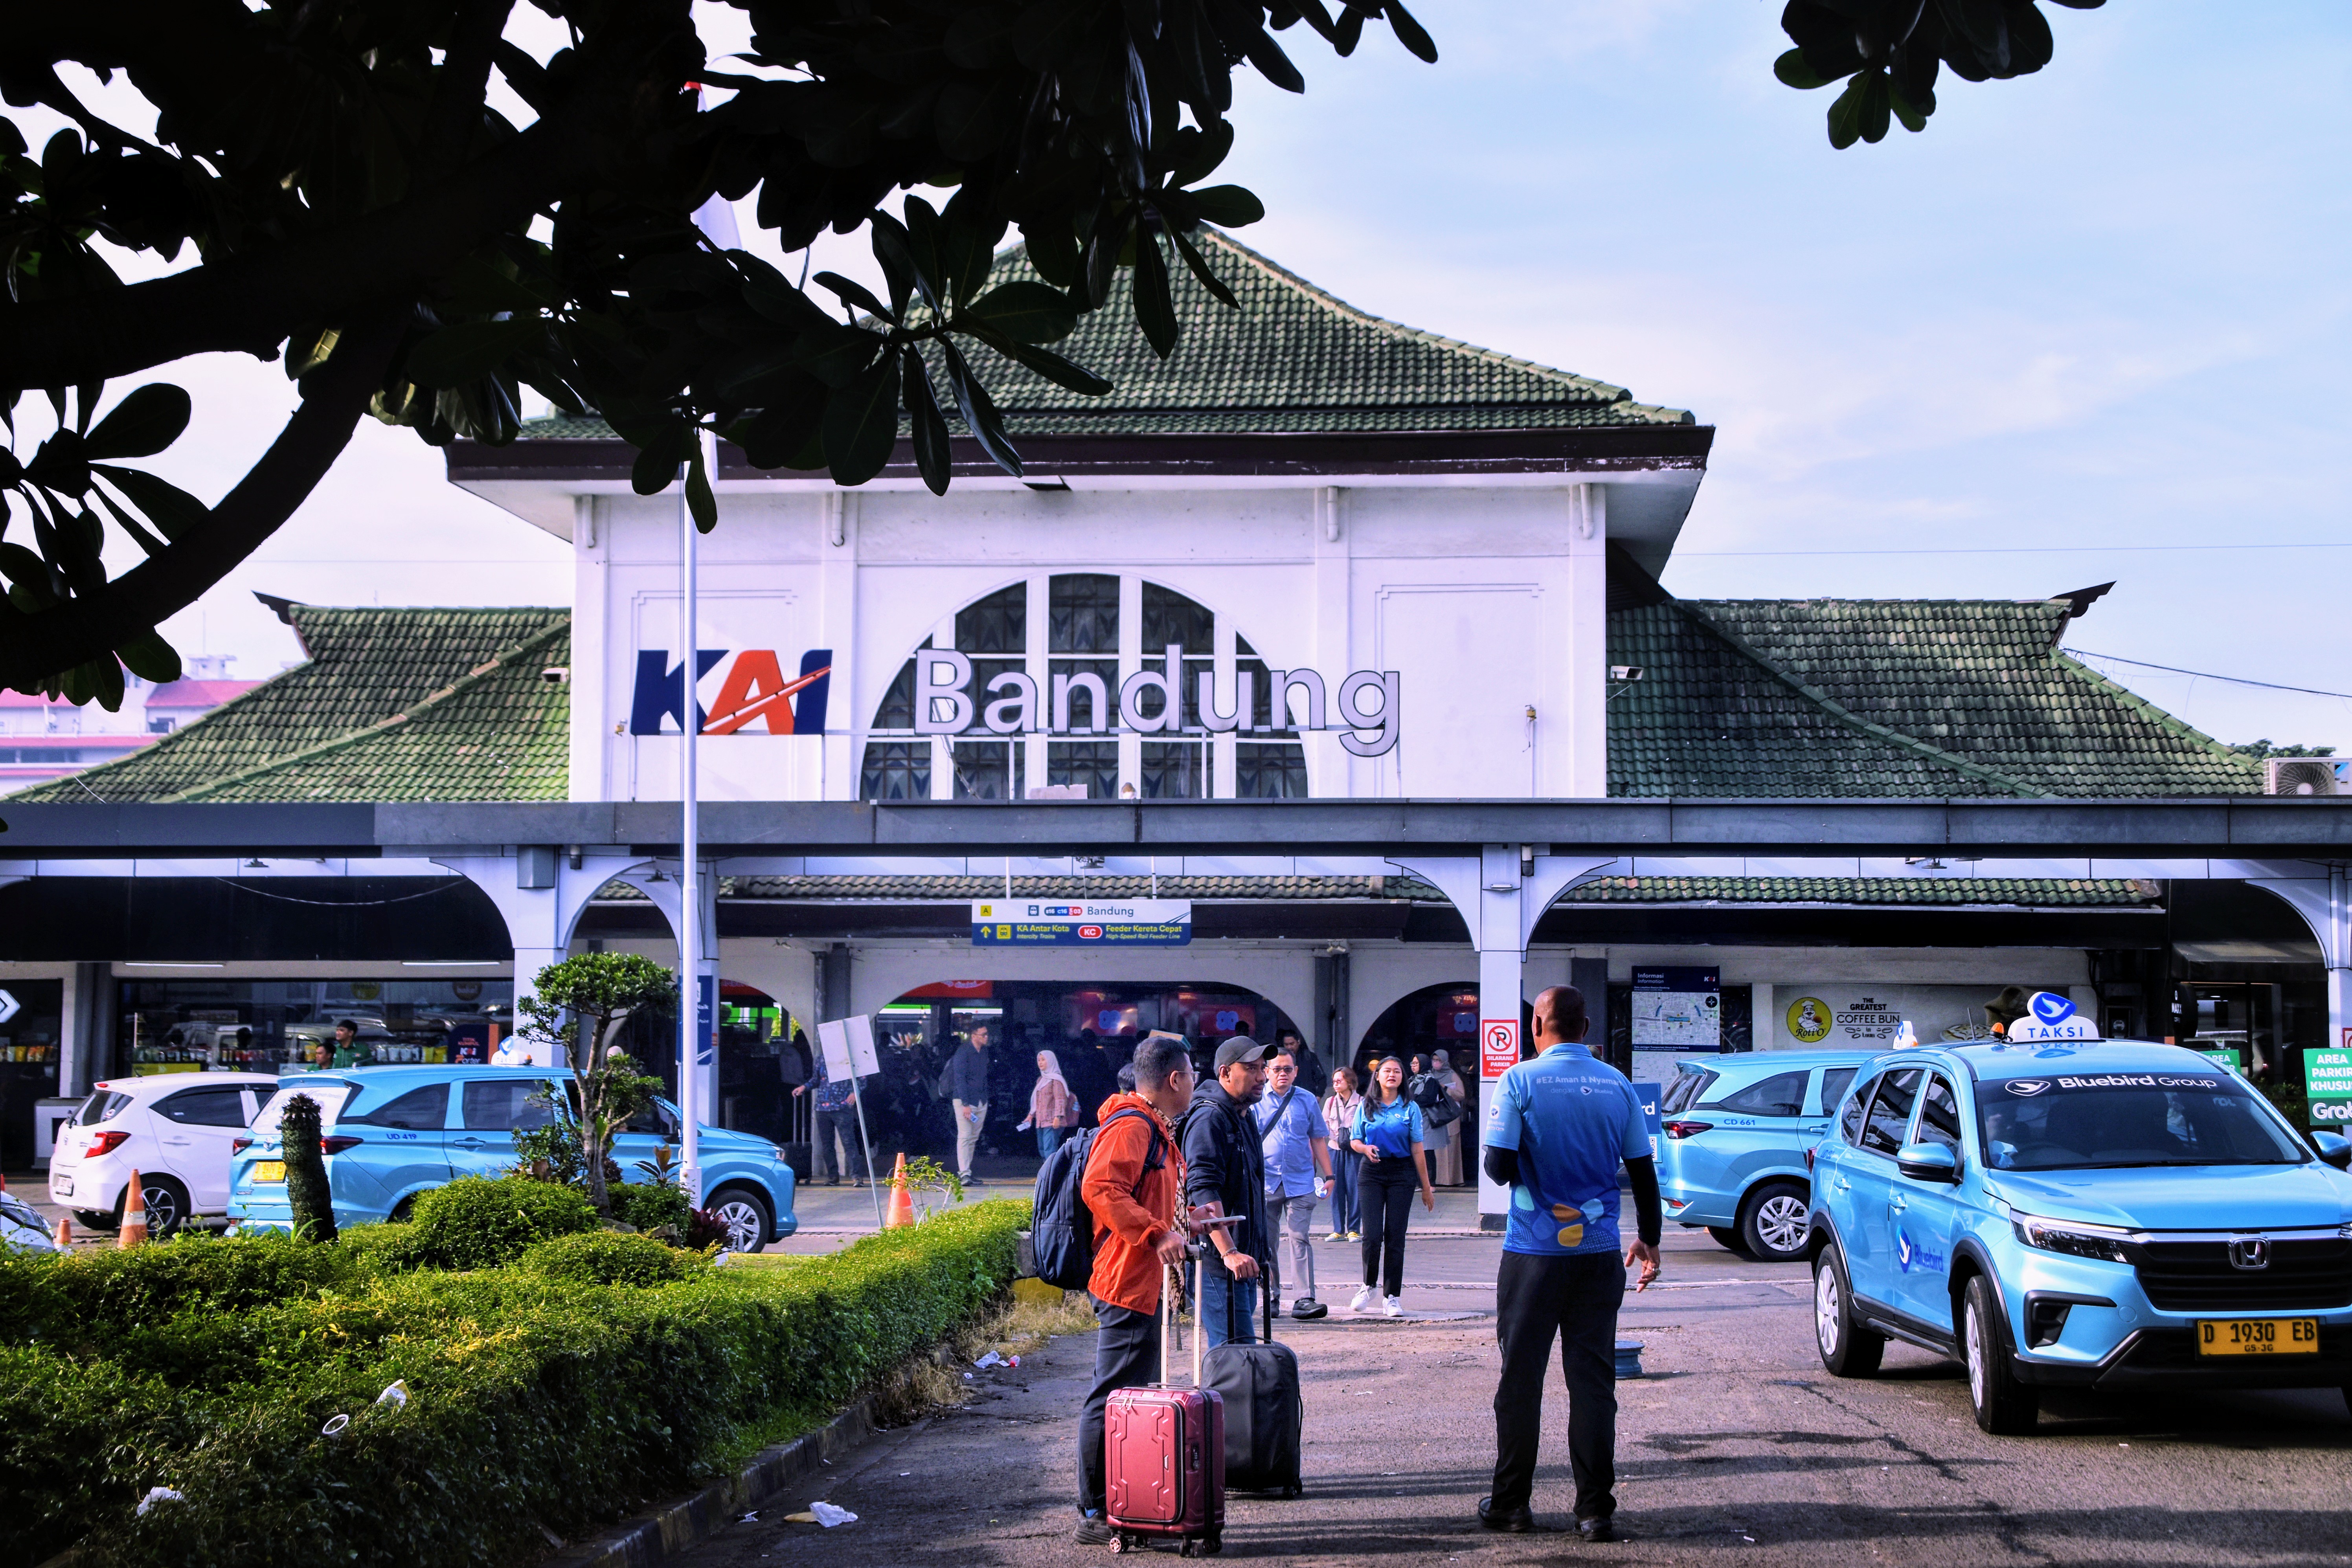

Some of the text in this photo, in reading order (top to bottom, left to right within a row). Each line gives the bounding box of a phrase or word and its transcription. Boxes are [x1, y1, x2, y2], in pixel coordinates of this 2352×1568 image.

[630, 643, 1400, 758] KAI Bandung
[1087, 906, 1134, 917] Bandung
[1836, 1015, 1900, 1023] COFFEE BUN
[2027, 1026, 2083, 1038] TAKSI
[2317, 1054, 2348, 1064] AREA
[1589, 1076, 1622, 1086] Nyaman
[2057, 1075, 2217, 1089] Bluebird Group
[2310, 1081, 2352, 1091] KHUSU
[1915, 1243, 1943, 1272] Bluebird
[2203, 1321, 2315, 1343] D 1930 EB
